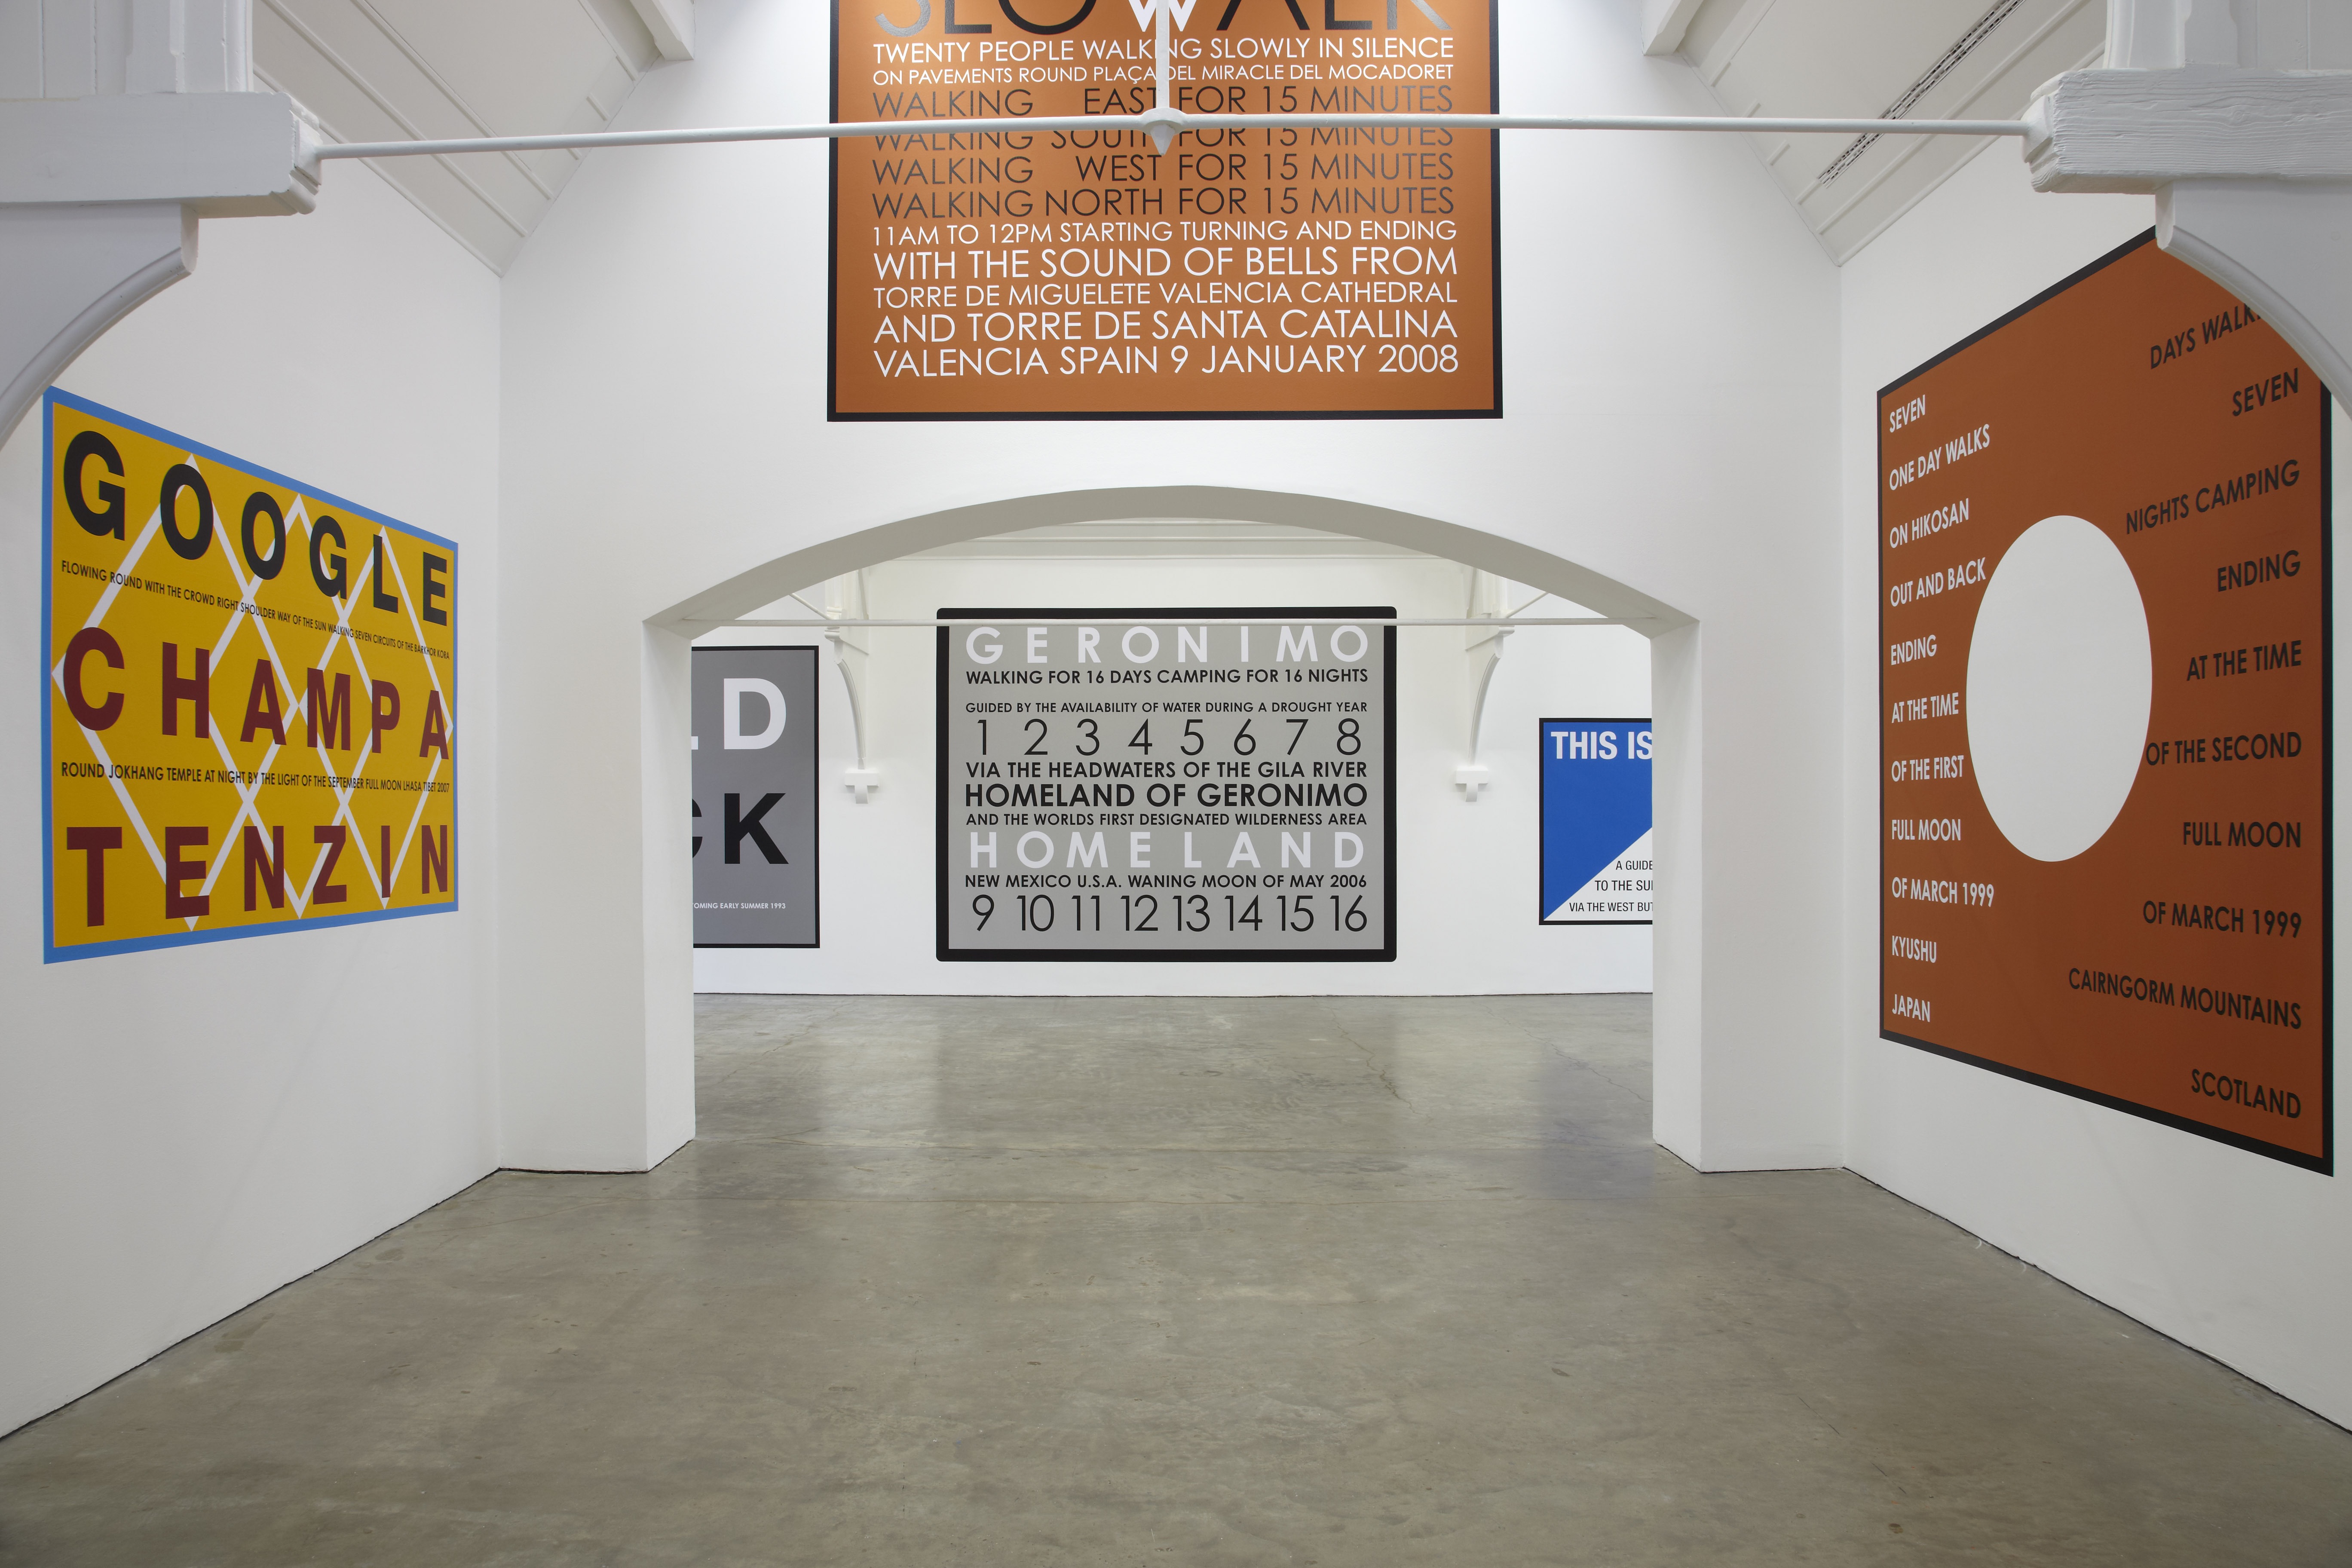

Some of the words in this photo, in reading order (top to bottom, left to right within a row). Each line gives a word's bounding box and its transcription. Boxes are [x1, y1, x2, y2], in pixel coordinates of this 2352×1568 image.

[873, 190, 1032, 218] WALKING
[1046, 189, 1161, 215] NORTH
[1180, 187, 1246, 214] FOR
[1265, 187, 1298, 213] 15
[1312, 186, 1454, 214] MINUTES
[874, 226, 939, 246] 11AM
[946, 224, 979, 244] TO
[990, 223, 1052, 243] 12PM
[1060, 221, 1172, 242] STARTING
[1180, 220, 1288, 241] TURNING
[1296, 220, 1352, 240] AND
[1360, 220, 1457, 240] ENDING
[873, 285, 956, 309] TORRE
[966, 285, 999, 306] DE
[1009, 283, 1150, 306] MIGUELETE
[1159, 281, 1292, 303] VALENCIA
[1301, 281, 1458, 303] CATHEDRAL
[873, 314, 956, 343] AND
[967, 311, 1081, 342] TORRE
[1095, 311, 1140, 340] DE
[1152, 310, 1268, 340] SANTA
[1280, 309, 1458, 339] CATALINA
[873, 347, 1049, 377] VALENCIA
[1060, 346, 1157, 375] SPAIN
[1171, 345, 1188, 374] 9
[1202, 345, 1366, 373] JANUARY
[1378, 344, 1458, 373] 2008
[2150, 328, 2196, 369] DAYS
[2233, 368, 2298, 416] SEVEN
[1890, 394, 1925, 433] SEVEN
[1890, 460, 1914, 490] ONE
[1918, 447, 1942, 478] DAY
[1945, 424, 1990, 464] WALKS
[2127, 494, 2189, 534] NIGHTS
[2196, 459, 2300, 513] CAMPING
[63, 431, 448, 626] GOOGLE
[1890, 523, 1908, 548] ON
[1912, 498, 1969, 541] HIKOSAN
[1890, 581, 1913, 607] OUT
[1916, 572, 1944, 600] AND
[1948, 557, 1986, 590] BACK
[61, 560, 107, 582] FLOWING
[109, 571, 142, 589] ROUND
[144, 579, 165, 594] WITH
[167, 585, 181, 598] THE
[184, 589, 215, 605] CROWD
[217, 597, 239, 611] RIGHT
[241, 602, 276, 619] SHOULDER
[277, 611, 291, 623] WAY
[293, 615, 301, 625] OF
[303, 617, 313, 628] THE
[315, 620, 326, 631] SUN
[328, 623, 354, 638] WALKING
[355, 630, 371, 642] SEVEN
[373, 634, 396, 647] CIRCUITS
[397, 640, 404, 649] OF
[405, 642, 413, 652] THE
[414, 644, 436, 656] BARKHOR
[437, 649, 449, 659] KORA
[966, 625, 1368, 664] GERONIMO
[1891, 634, 1937, 665] ENDING
[966, 671, 1043, 684] WALKING
[1049, 671, 1080, 684] FOR
[1087, 671, 1104, 683] 16
[1111, 670, 1152, 683] DAYS
[1157, 669, 1240, 683] CAMPING
[1247, 669, 1278, 683] FOR
[1285, 669, 1302, 683] 16
[1309, 668, 1368, 682] NIGHTS
[63, 627, 449, 760] CHAMPA
[966, 703, 1012, 713] GUIDED
[1017, 703, 1032, 712] BY
[1035, 702, 1056, 713] THE
[1060, 702, 1137, 712] AVAILABILITY
[1142, 702, 1158, 713] OF
[1163, 702, 1200, 712] WATER
[1206, 702, 1253, 712] DURING
[1258, 702, 1267, 712] A
[1272, 702, 1332, 712] DROUGHT
[1336, 702, 1367, 712] YEAR
[1892, 701, 1905, 723] AT
[1907, 698, 1927, 721] THE
[1930, 692, 1959, 717] TIME
[1551, 731, 1617, 760] THIS
[1628, 731, 1652, 760] IS
[2146, 741, 2169, 766] OF
[2175, 739, 2205, 763] THE
[2212, 732, 2302, 762] SECOND
[61, 762, 105, 778] ROUND
[108, 764, 164, 781] JOKHANG
[166, 767, 201, 782] TEMPLE
[204, 769, 215, 782] AT
[217, 770, 245, 784] NIGHT
[248, 772, 258, 784] BY
[261, 772, 275, 785] THE
[278, 773, 299, 786] LIGHT
[301, 775, 312, 787] OF
[313, 775, 326, 787] THE
[328, 776, 364, 789] SEPTEMBER
[366, 778, 379, 790] FULL
[380, 779, 401, 790] MOON
[403, 781, 422, 791] LHASA
[423, 781, 436, 792] TIBET
[437, 782, 450, 793] 2007
[1891, 760, 1907, 782] OF
[1910, 758, 1930, 780] THE
[1934, 755, 1964, 779] FIRST
[966, 783, 1134, 807] HOMELAND
[1147, 783, 1185, 807] OF
[1197, 783, 1367, 807] GERONIMO
[966, 814, 998, 825] AND
[1004, 814, 1028, 825] THE
[1034, 813, 1094, 825] WORLDS
[1100, 813, 1134, 825] FIRST
[1140, 813, 1229, 825] DESIGNATED
[1235, 813, 1322, 825] WILDERNESS
[1328, 813, 1367, 825] AREA
[1892, 819, 1915, 840] FULL
[1918, 818, 1961, 841] MOON
[971, 831, 1363, 869] HOMELAND
[1616, 861, 1622, 870] A
[1626, 861, 1653, 870] GUIDE
[66, 825, 448, 928] TENZIN
[965, 875, 1000, 887] NEW
[1005, 875, 1071, 888] MEXICO
[1078, 875, 1121, 888] U.S.A.
[1128, 875, 1196, 888] WANING
[1202, 875, 1256, 888] MOON
[1263, 875, 1284, 888] OF
[1290, 875, 1324, 888] MAY
[1330, 875, 1366, 888] 2006
[1595, 880, 1608, 891] TO
[1611, 880, 1632, 891] THE
[1636, 880, 1653, 891] SU
[1892, 877, 1907, 898] OF
[1911, 879, 1957, 904] MARCH
[1963, 882, 1994, 907] 1999
[1569, 902, 1584, 912] VIA
[1586, 902, 1605, 912] THE
[1608, 902, 1634, 912] WEST
[1892, 935, 1937, 963] KYUSHU
[1892, 994, 1930, 1022] JAPAN
[2069, 968, 2175, 1006] CAIRNGORM
[2180, 985, 2301, 1029] MOUNTAINS
[2192, 1069, 2301, 1118] SCOTLAND
